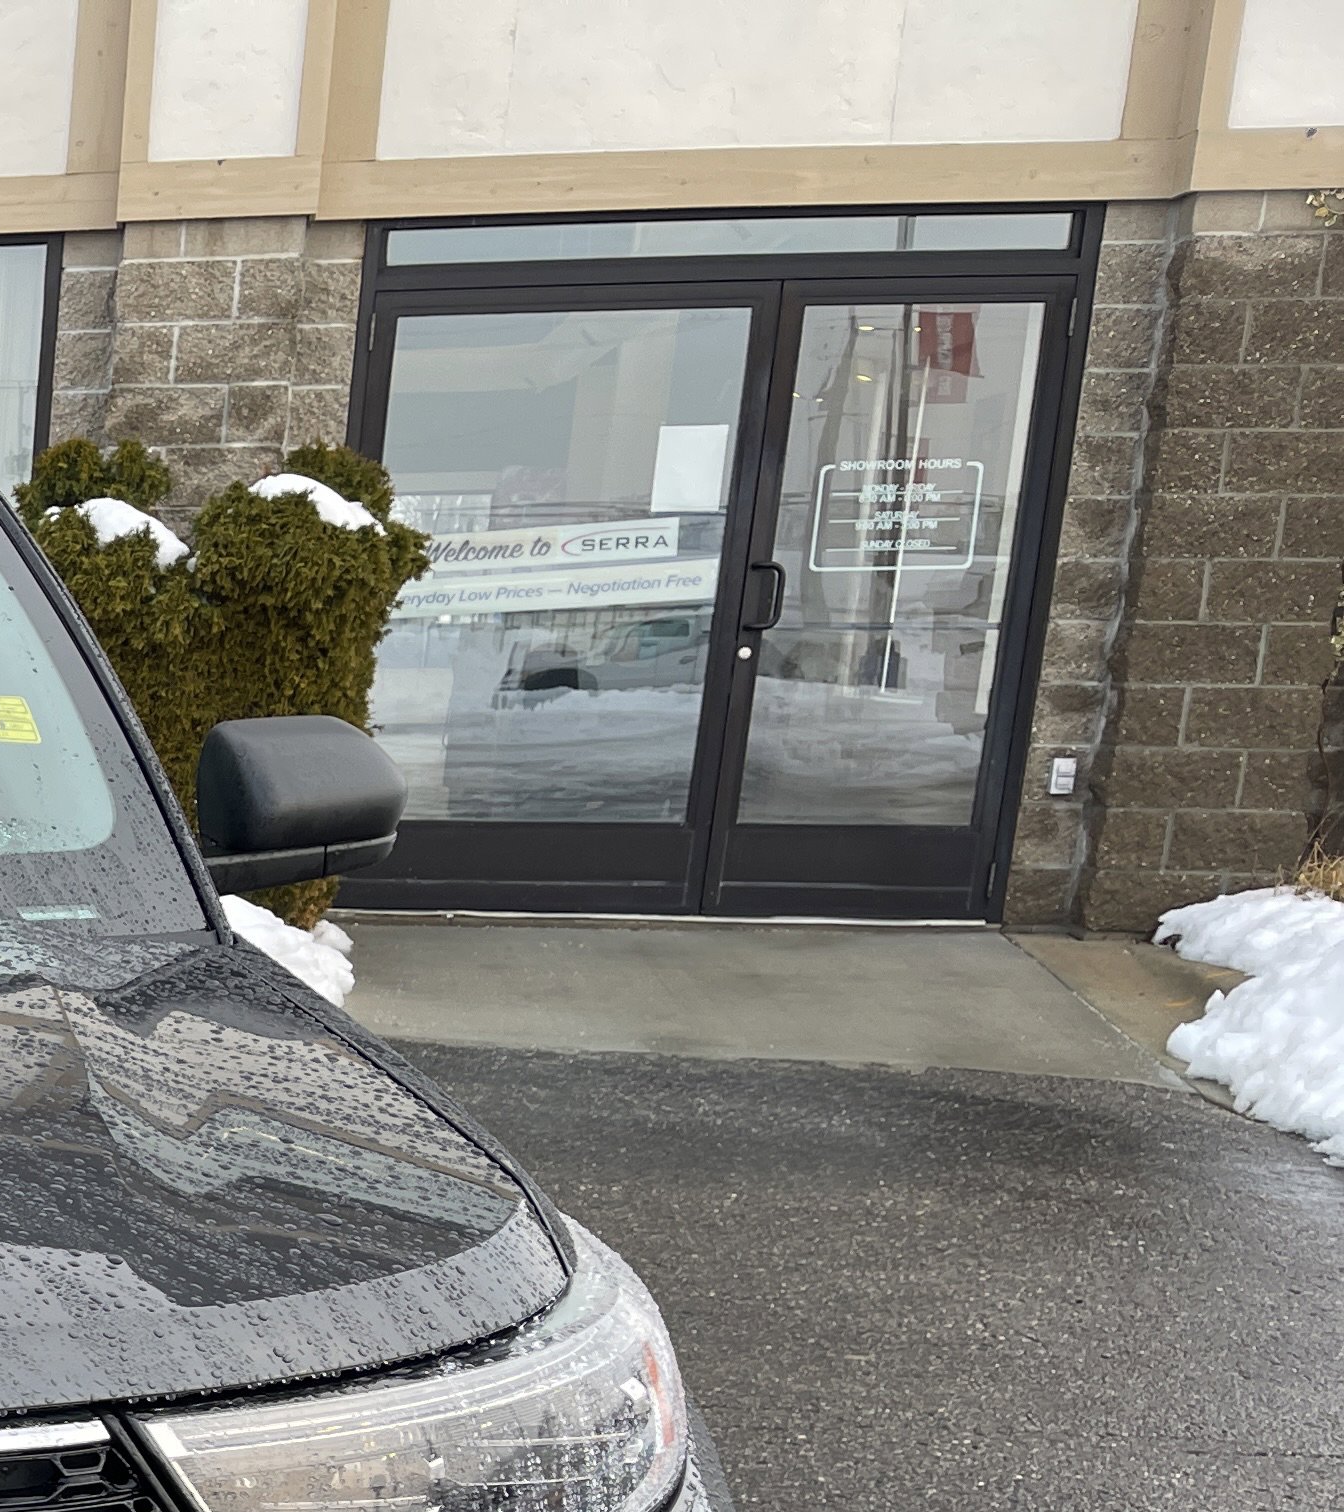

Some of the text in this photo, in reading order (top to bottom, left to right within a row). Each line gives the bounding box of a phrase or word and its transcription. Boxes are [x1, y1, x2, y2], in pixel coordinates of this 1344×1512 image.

[840, 458, 962, 471] SHOWROOM HOURS
[426, 535, 669, 563] Welcome to SERRA
[459, 590, 492, 602] Low
[495, 586, 543, 599] Prices
[567, 579, 661, 597] Negotiation
[665, 574, 702, 588] Free
